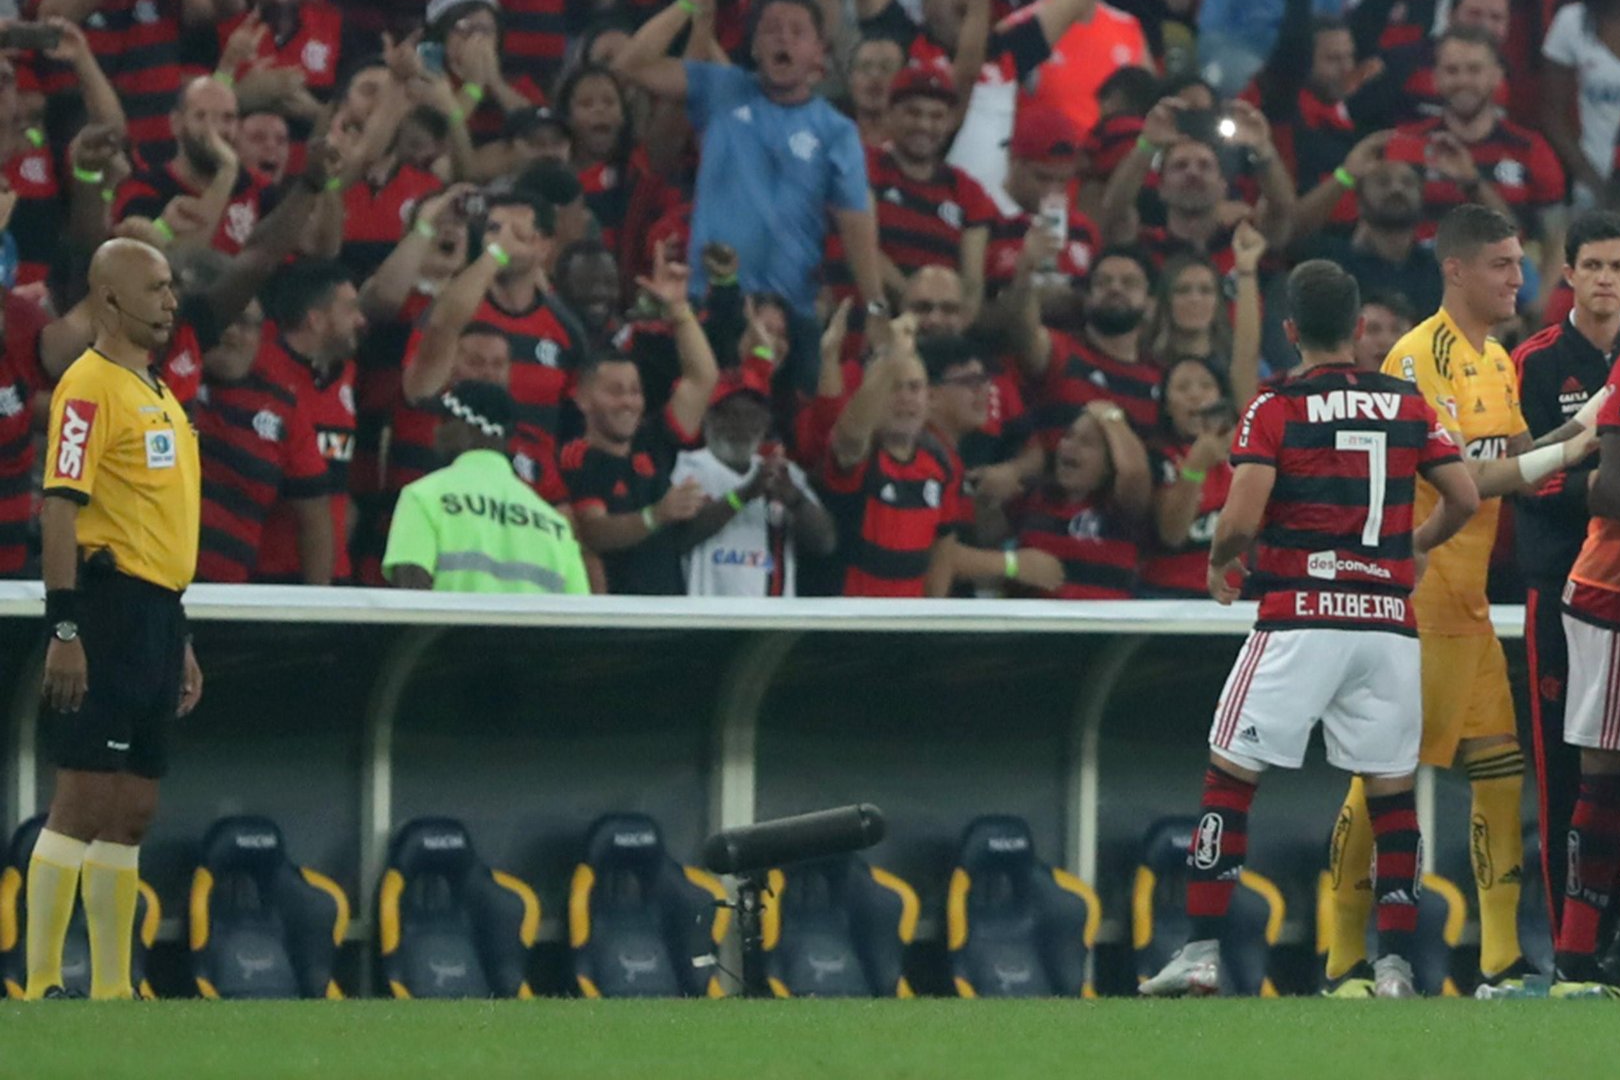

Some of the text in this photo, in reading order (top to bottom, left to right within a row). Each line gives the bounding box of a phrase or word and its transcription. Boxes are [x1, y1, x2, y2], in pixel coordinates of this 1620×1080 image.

[1306, 389, 1400, 423] MRV
[58, 405, 89, 479] SKY
[1335, 429, 1387, 547] 7
[439, 493, 566, 540] SUNSET
[1319, 591, 1406, 622] RIBEIRO
